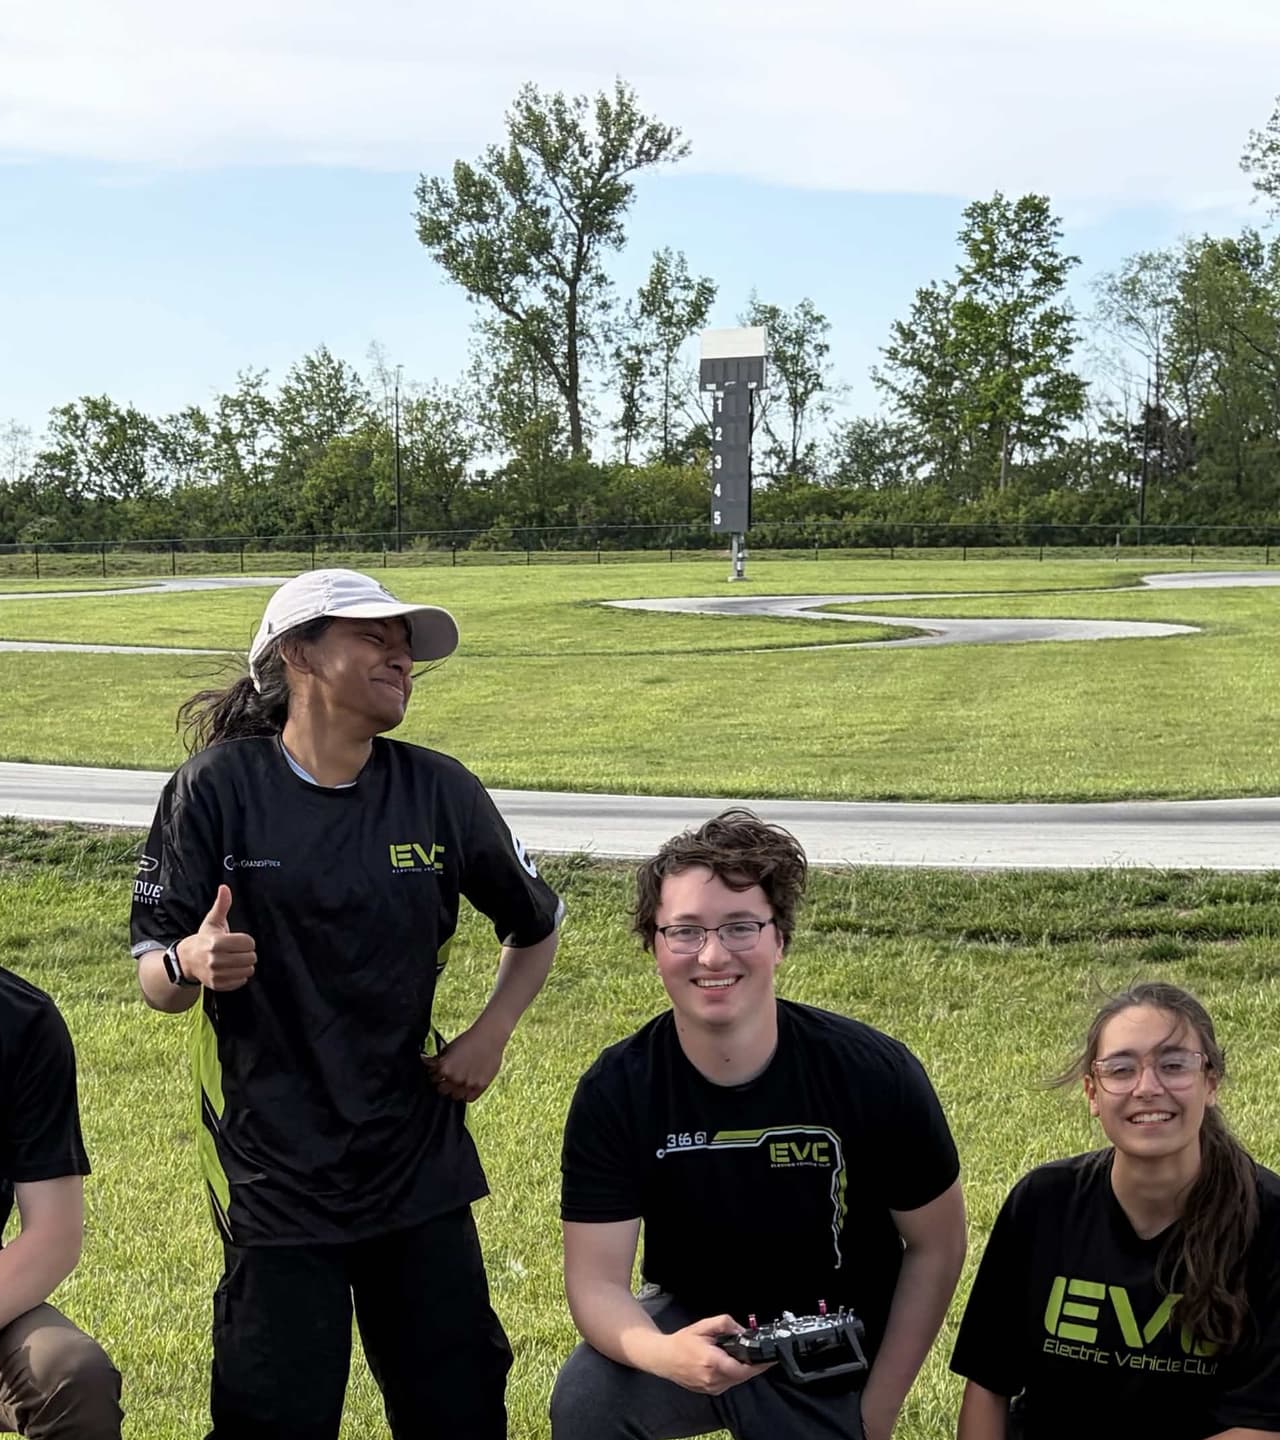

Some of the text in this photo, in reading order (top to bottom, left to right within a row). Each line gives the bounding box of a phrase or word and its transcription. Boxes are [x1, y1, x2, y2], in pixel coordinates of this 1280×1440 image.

[716, 398, 722, 413] 1
[715, 426, 722, 441] 2
[714, 455, 722, 469] 3
[714, 483, 721, 497] 4
[714, 511, 721, 525] 5
[133, 879, 164, 898] DUE
[770, 1142, 830, 1163] EVC
[1042, 1338, 1110, 1365] Electric
[1114, 1351, 1181, 1373] Vehicle
